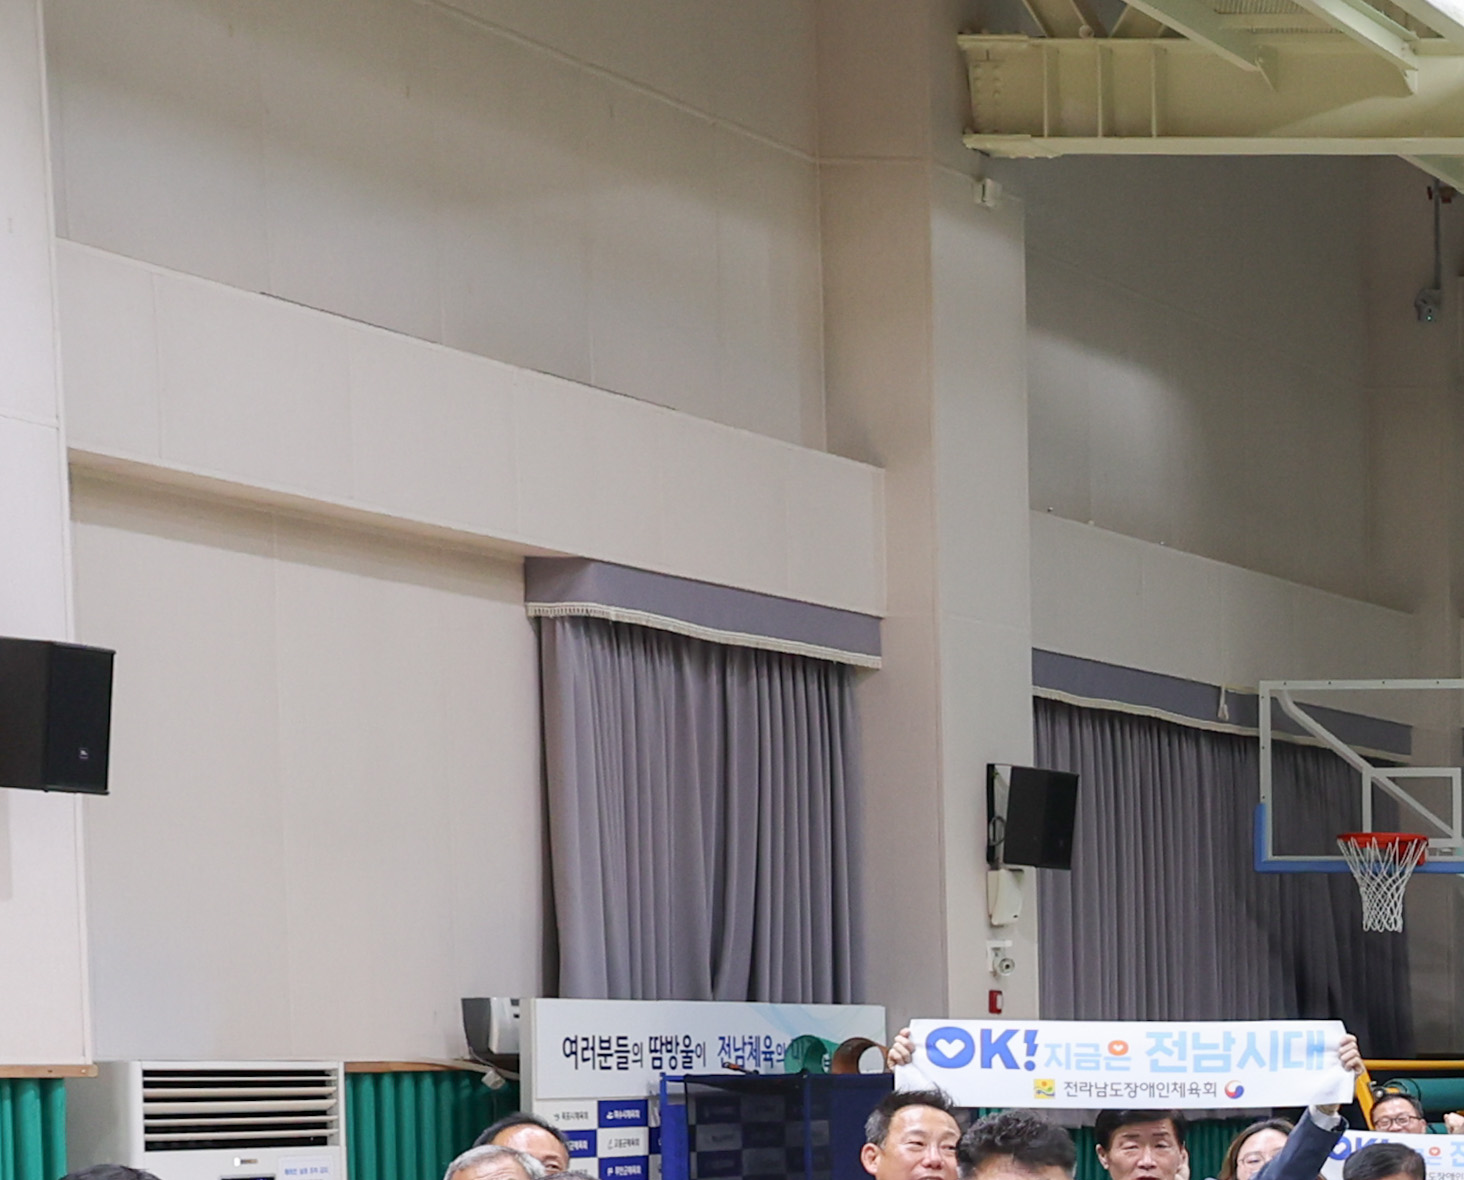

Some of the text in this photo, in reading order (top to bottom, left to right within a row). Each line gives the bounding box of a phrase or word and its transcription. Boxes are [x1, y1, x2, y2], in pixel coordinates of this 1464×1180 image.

[562, 1034, 643, 1071] 여러분들의
[649, 1034, 707, 1071] 땀방울이
[716, 1034, 786, 1070] 전남체육의
[925, 1025, 1325, 1073] OK! 지금은 전남시대
[1063, 1079, 1218, 1099] 전라남도장애인체육회
